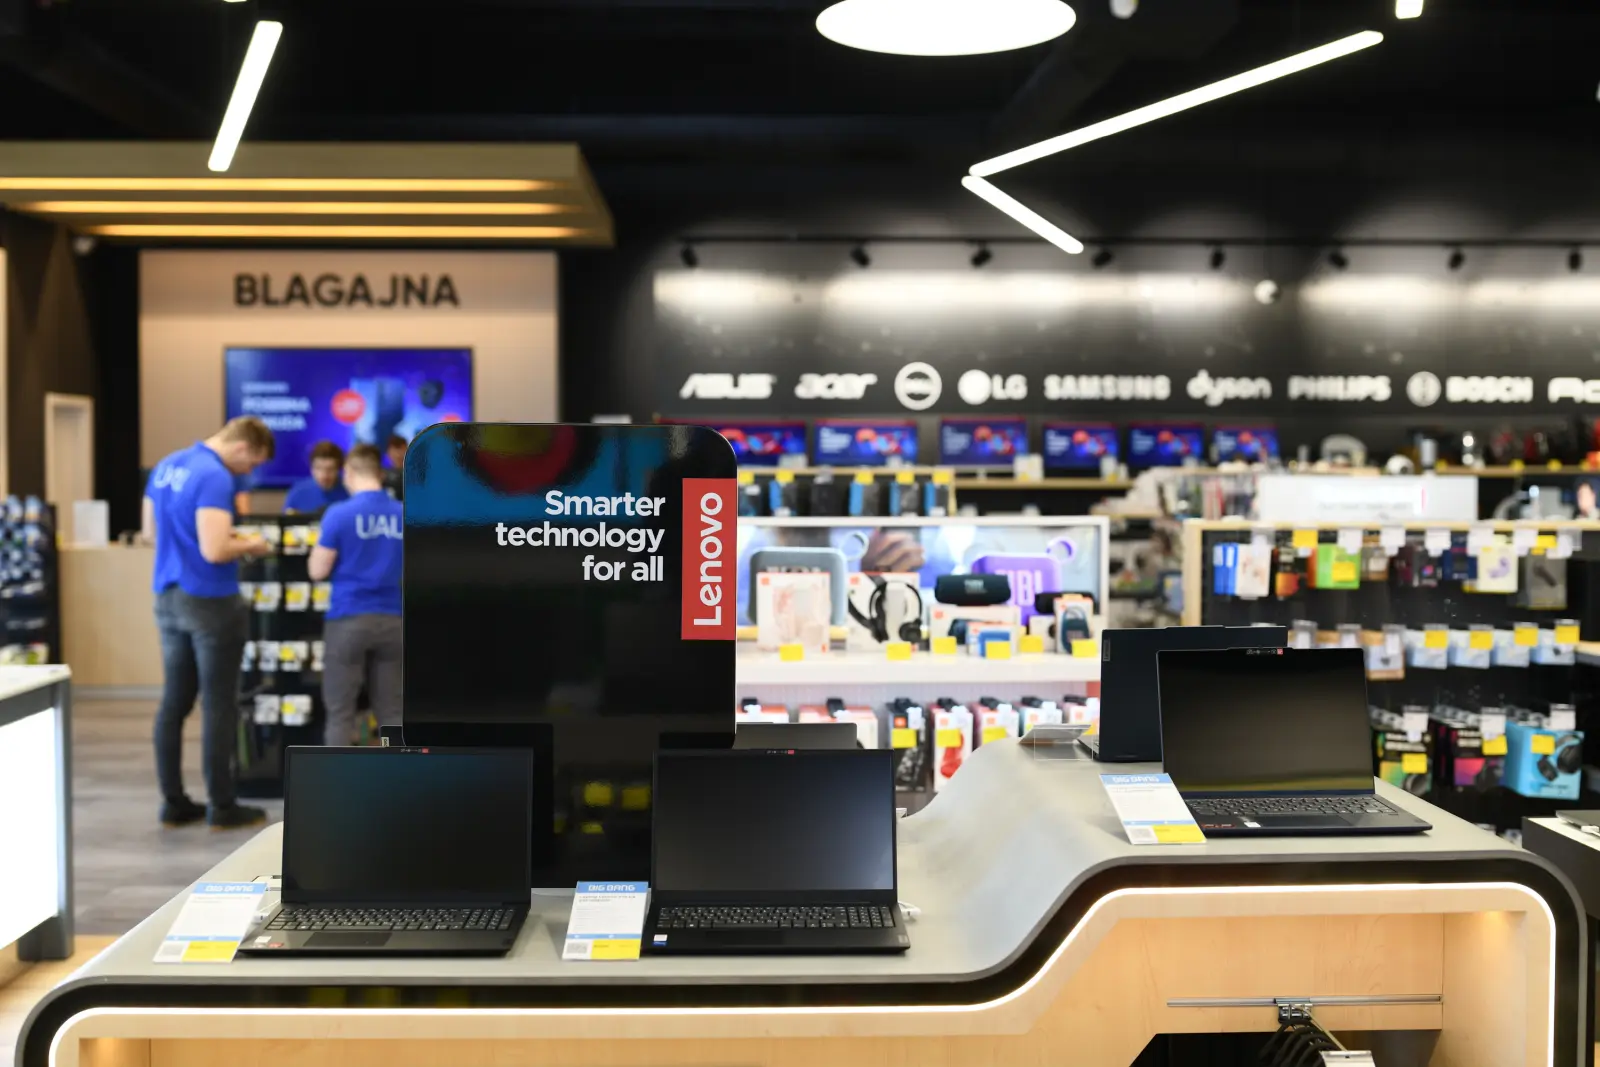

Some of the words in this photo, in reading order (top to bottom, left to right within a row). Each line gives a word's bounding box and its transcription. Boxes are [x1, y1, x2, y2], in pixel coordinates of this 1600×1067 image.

[233, 273, 460, 308] BLAGAJNA
[679, 373, 777, 399] ASUS
[991, 374, 1028, 400] LG
[1044, 374, 1171, 401] SAMSUNG
[1186, 369, 1272, 407] dyson
[1288, 375, 1392, 401] PHILIPS
[1446, 376, 1534, 402] BOSCH
[544, 490, 666, 516] Smarter
[495, 521, 666, 553] technology
[582, 555, 626, 581] for
[631, 556, 664, 581] all
[694, 492, 723, 626] Lenovo
